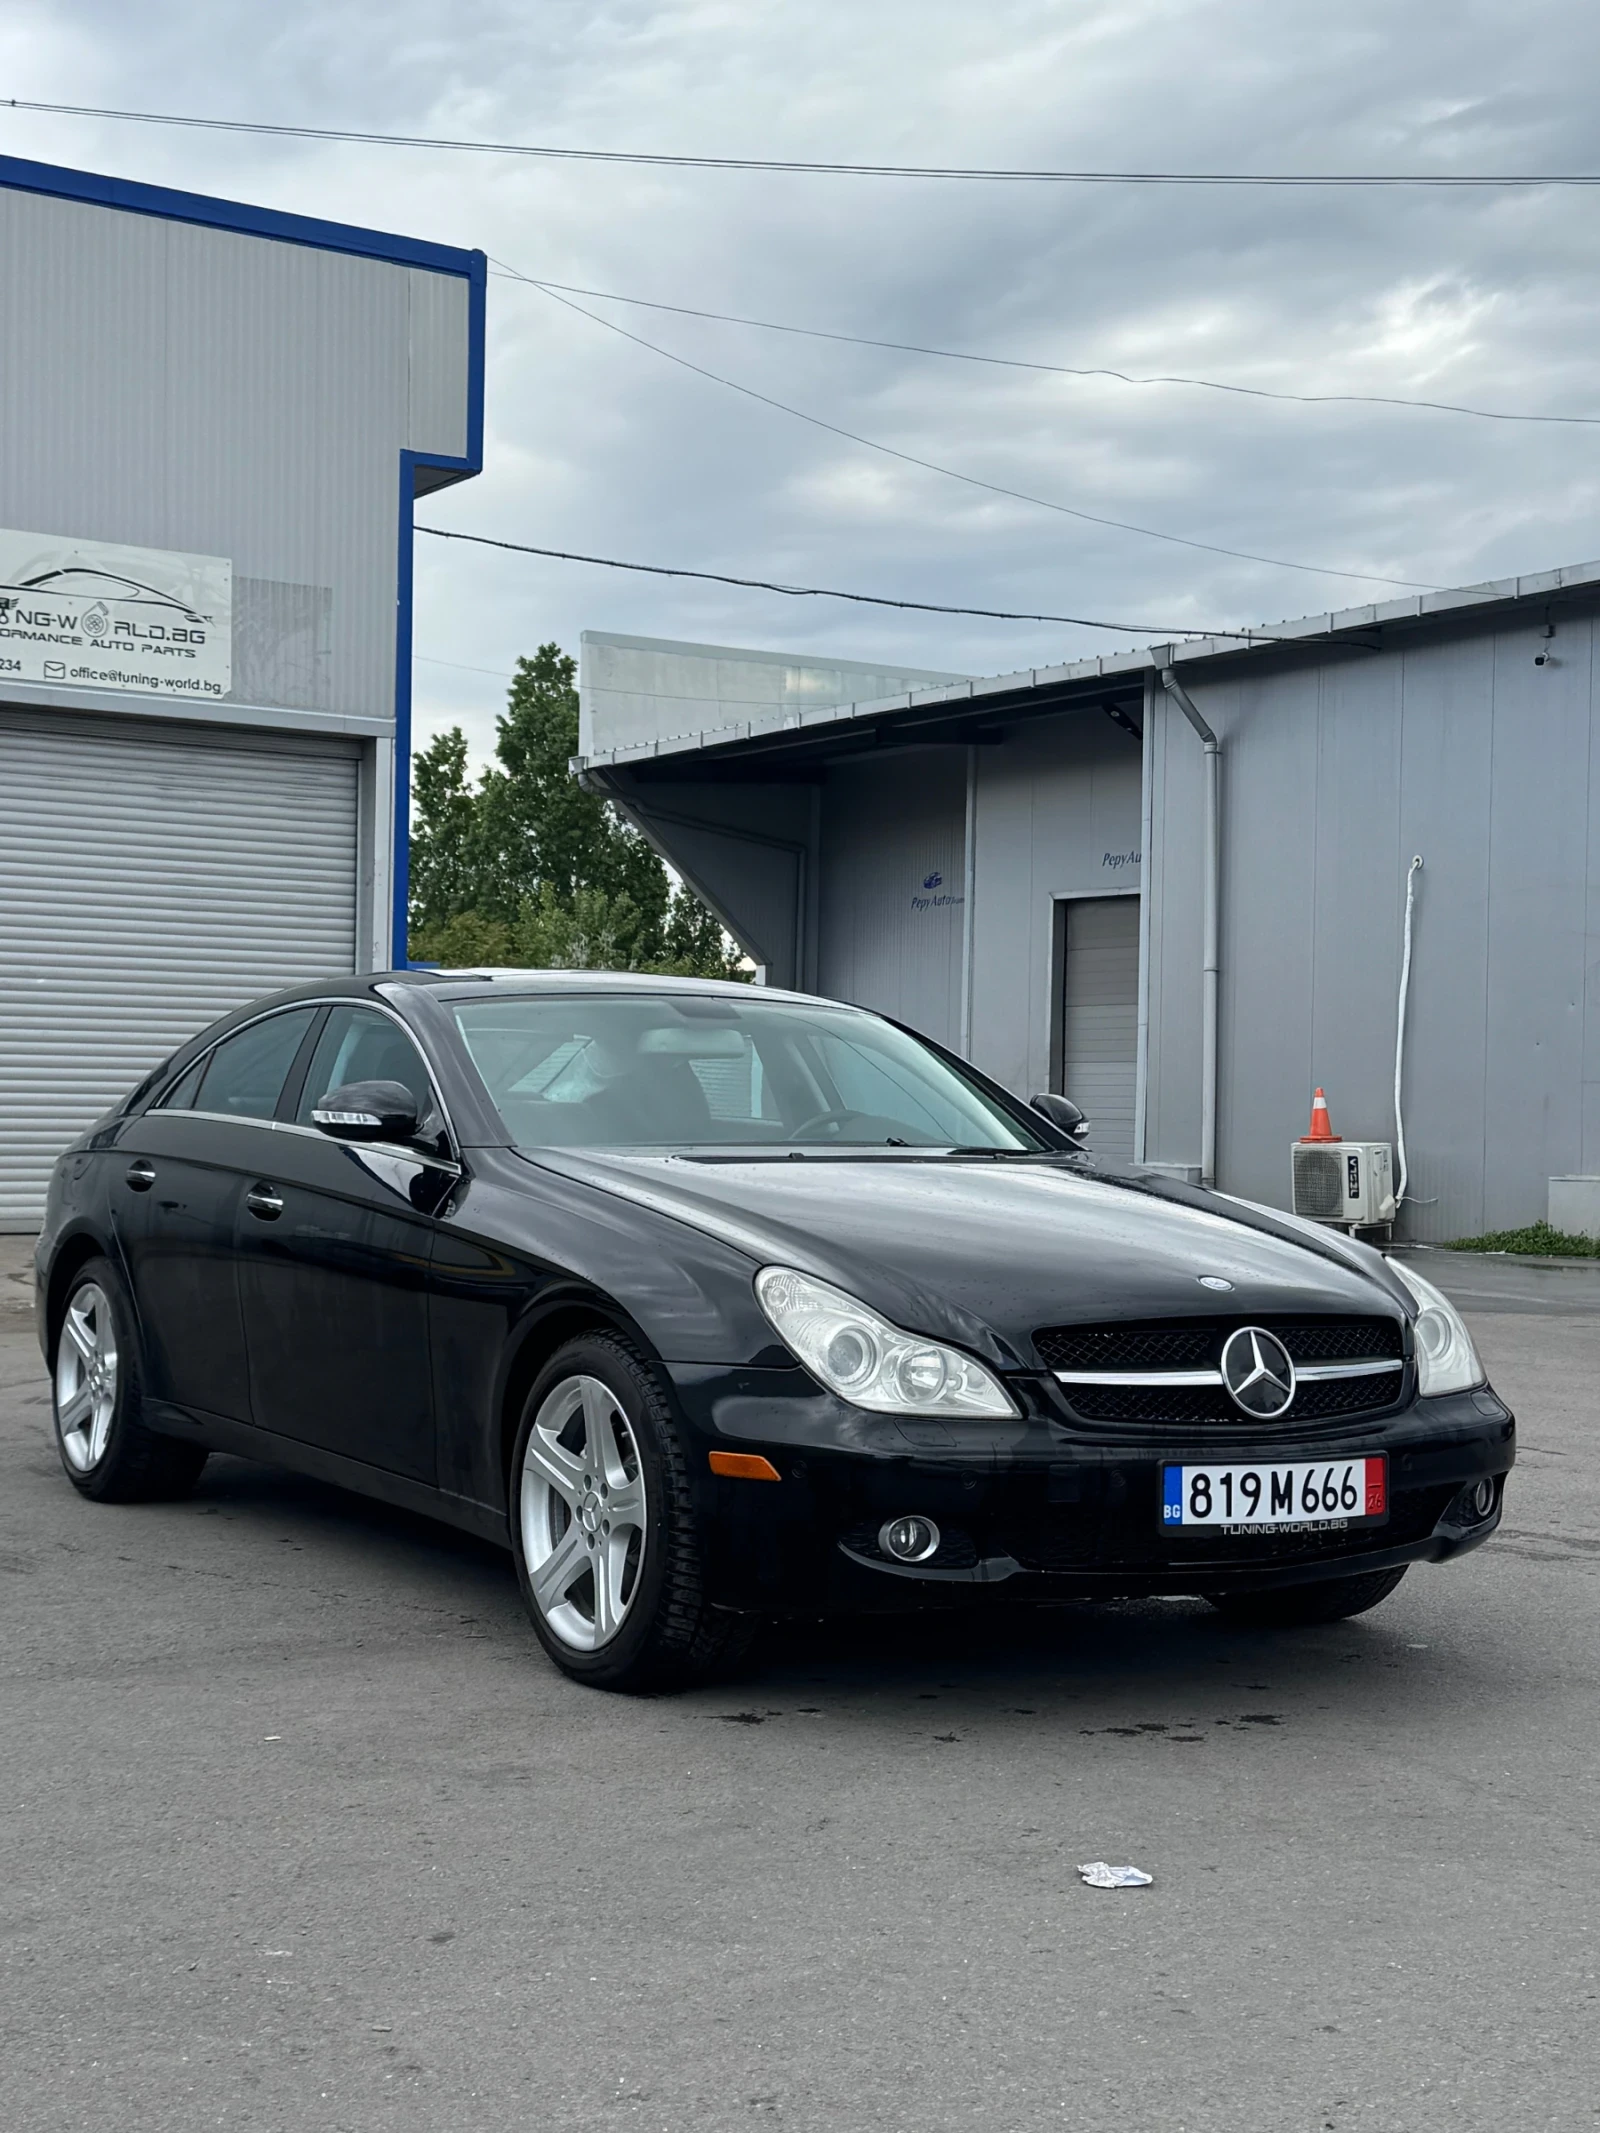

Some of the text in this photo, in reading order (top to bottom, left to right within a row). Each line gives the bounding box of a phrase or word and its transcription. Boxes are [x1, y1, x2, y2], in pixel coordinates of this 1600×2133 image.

[90, 638, 135, 651] AUTO
[141, 644, 197, 658] PARTS
[70, 666, 222, 695] office@tuning-world.bg
[1349, 1158, 1359, 1197] TESLA
[1164, 1504, 1181, 1519] BG
[1220, 1518, 1348, 1535] TUNING-WORLD.BG
